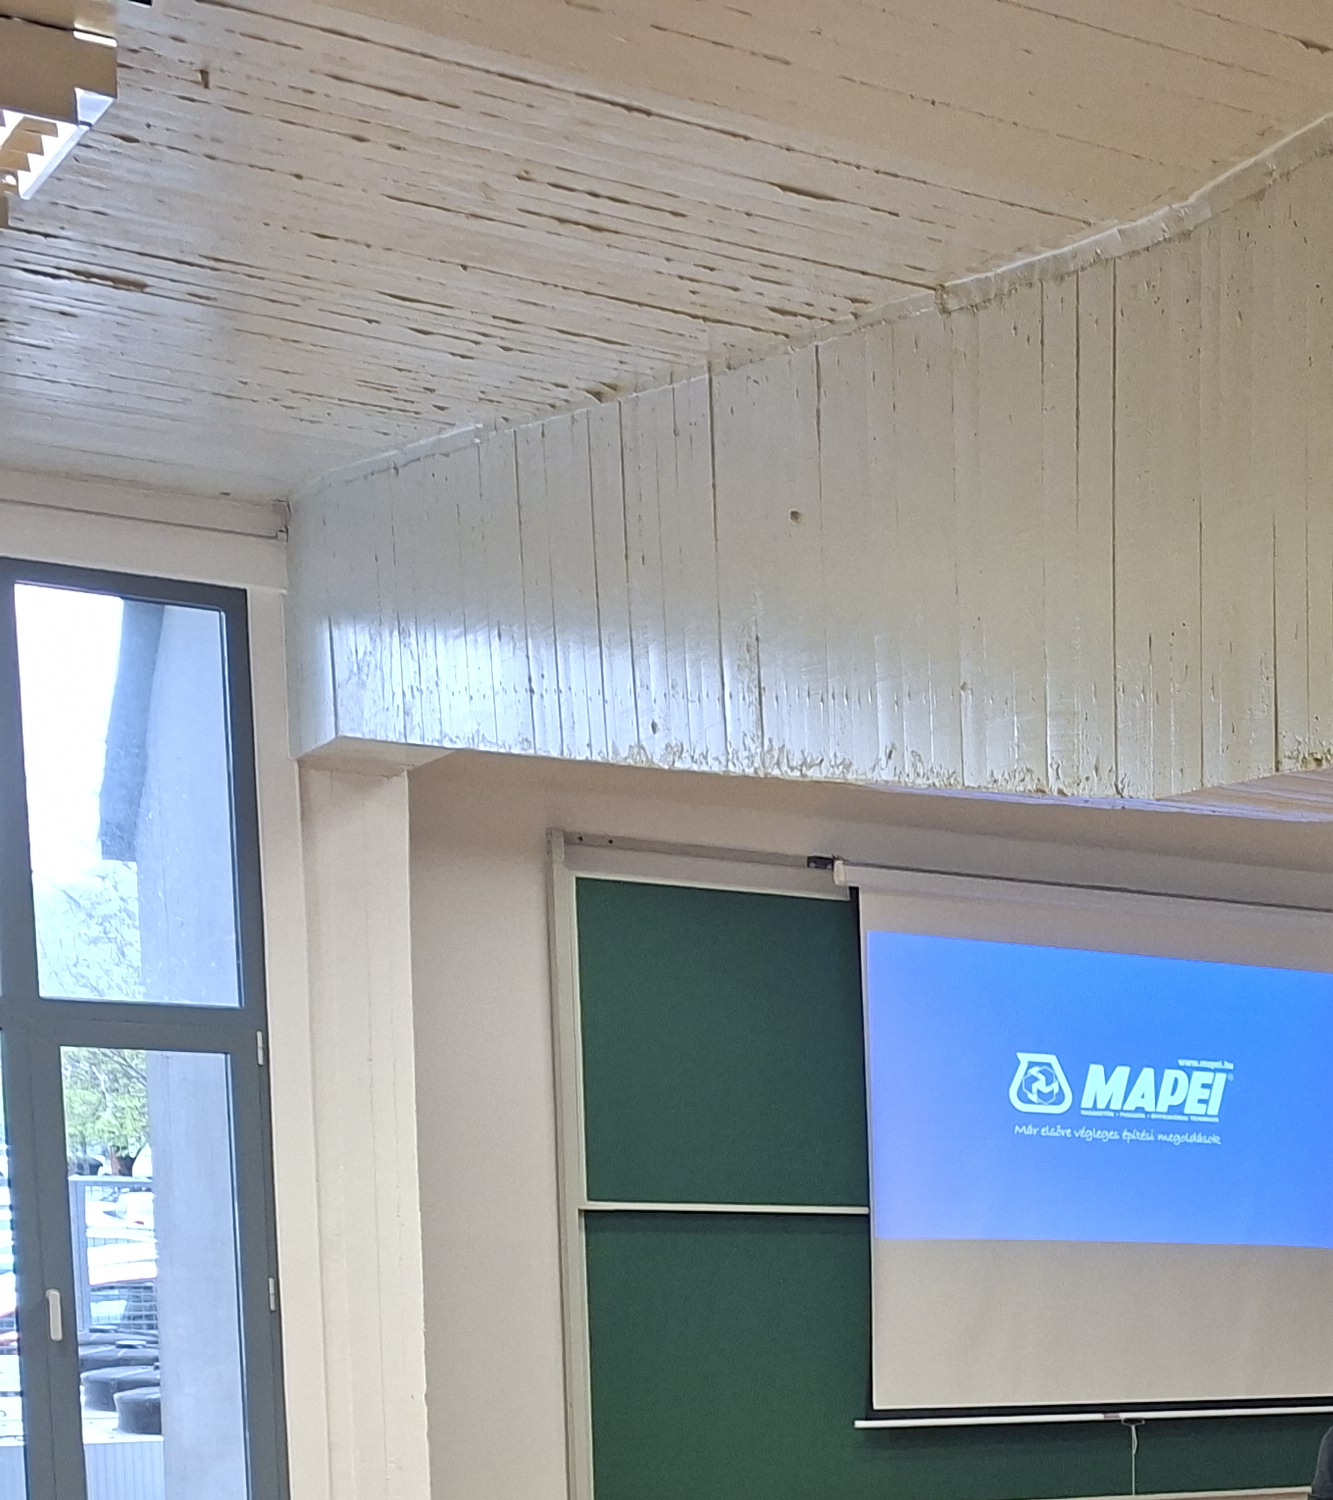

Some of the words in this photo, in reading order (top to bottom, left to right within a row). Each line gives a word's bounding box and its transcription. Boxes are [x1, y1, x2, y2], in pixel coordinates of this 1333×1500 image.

[1080, 1063, 1228, 1116] MAPEI
[1014, 1124, 1038, 1136] Már
[1074, 1125, 1120, 1142] végleges
[1157, 1131, 1222, 1146] megoldások
